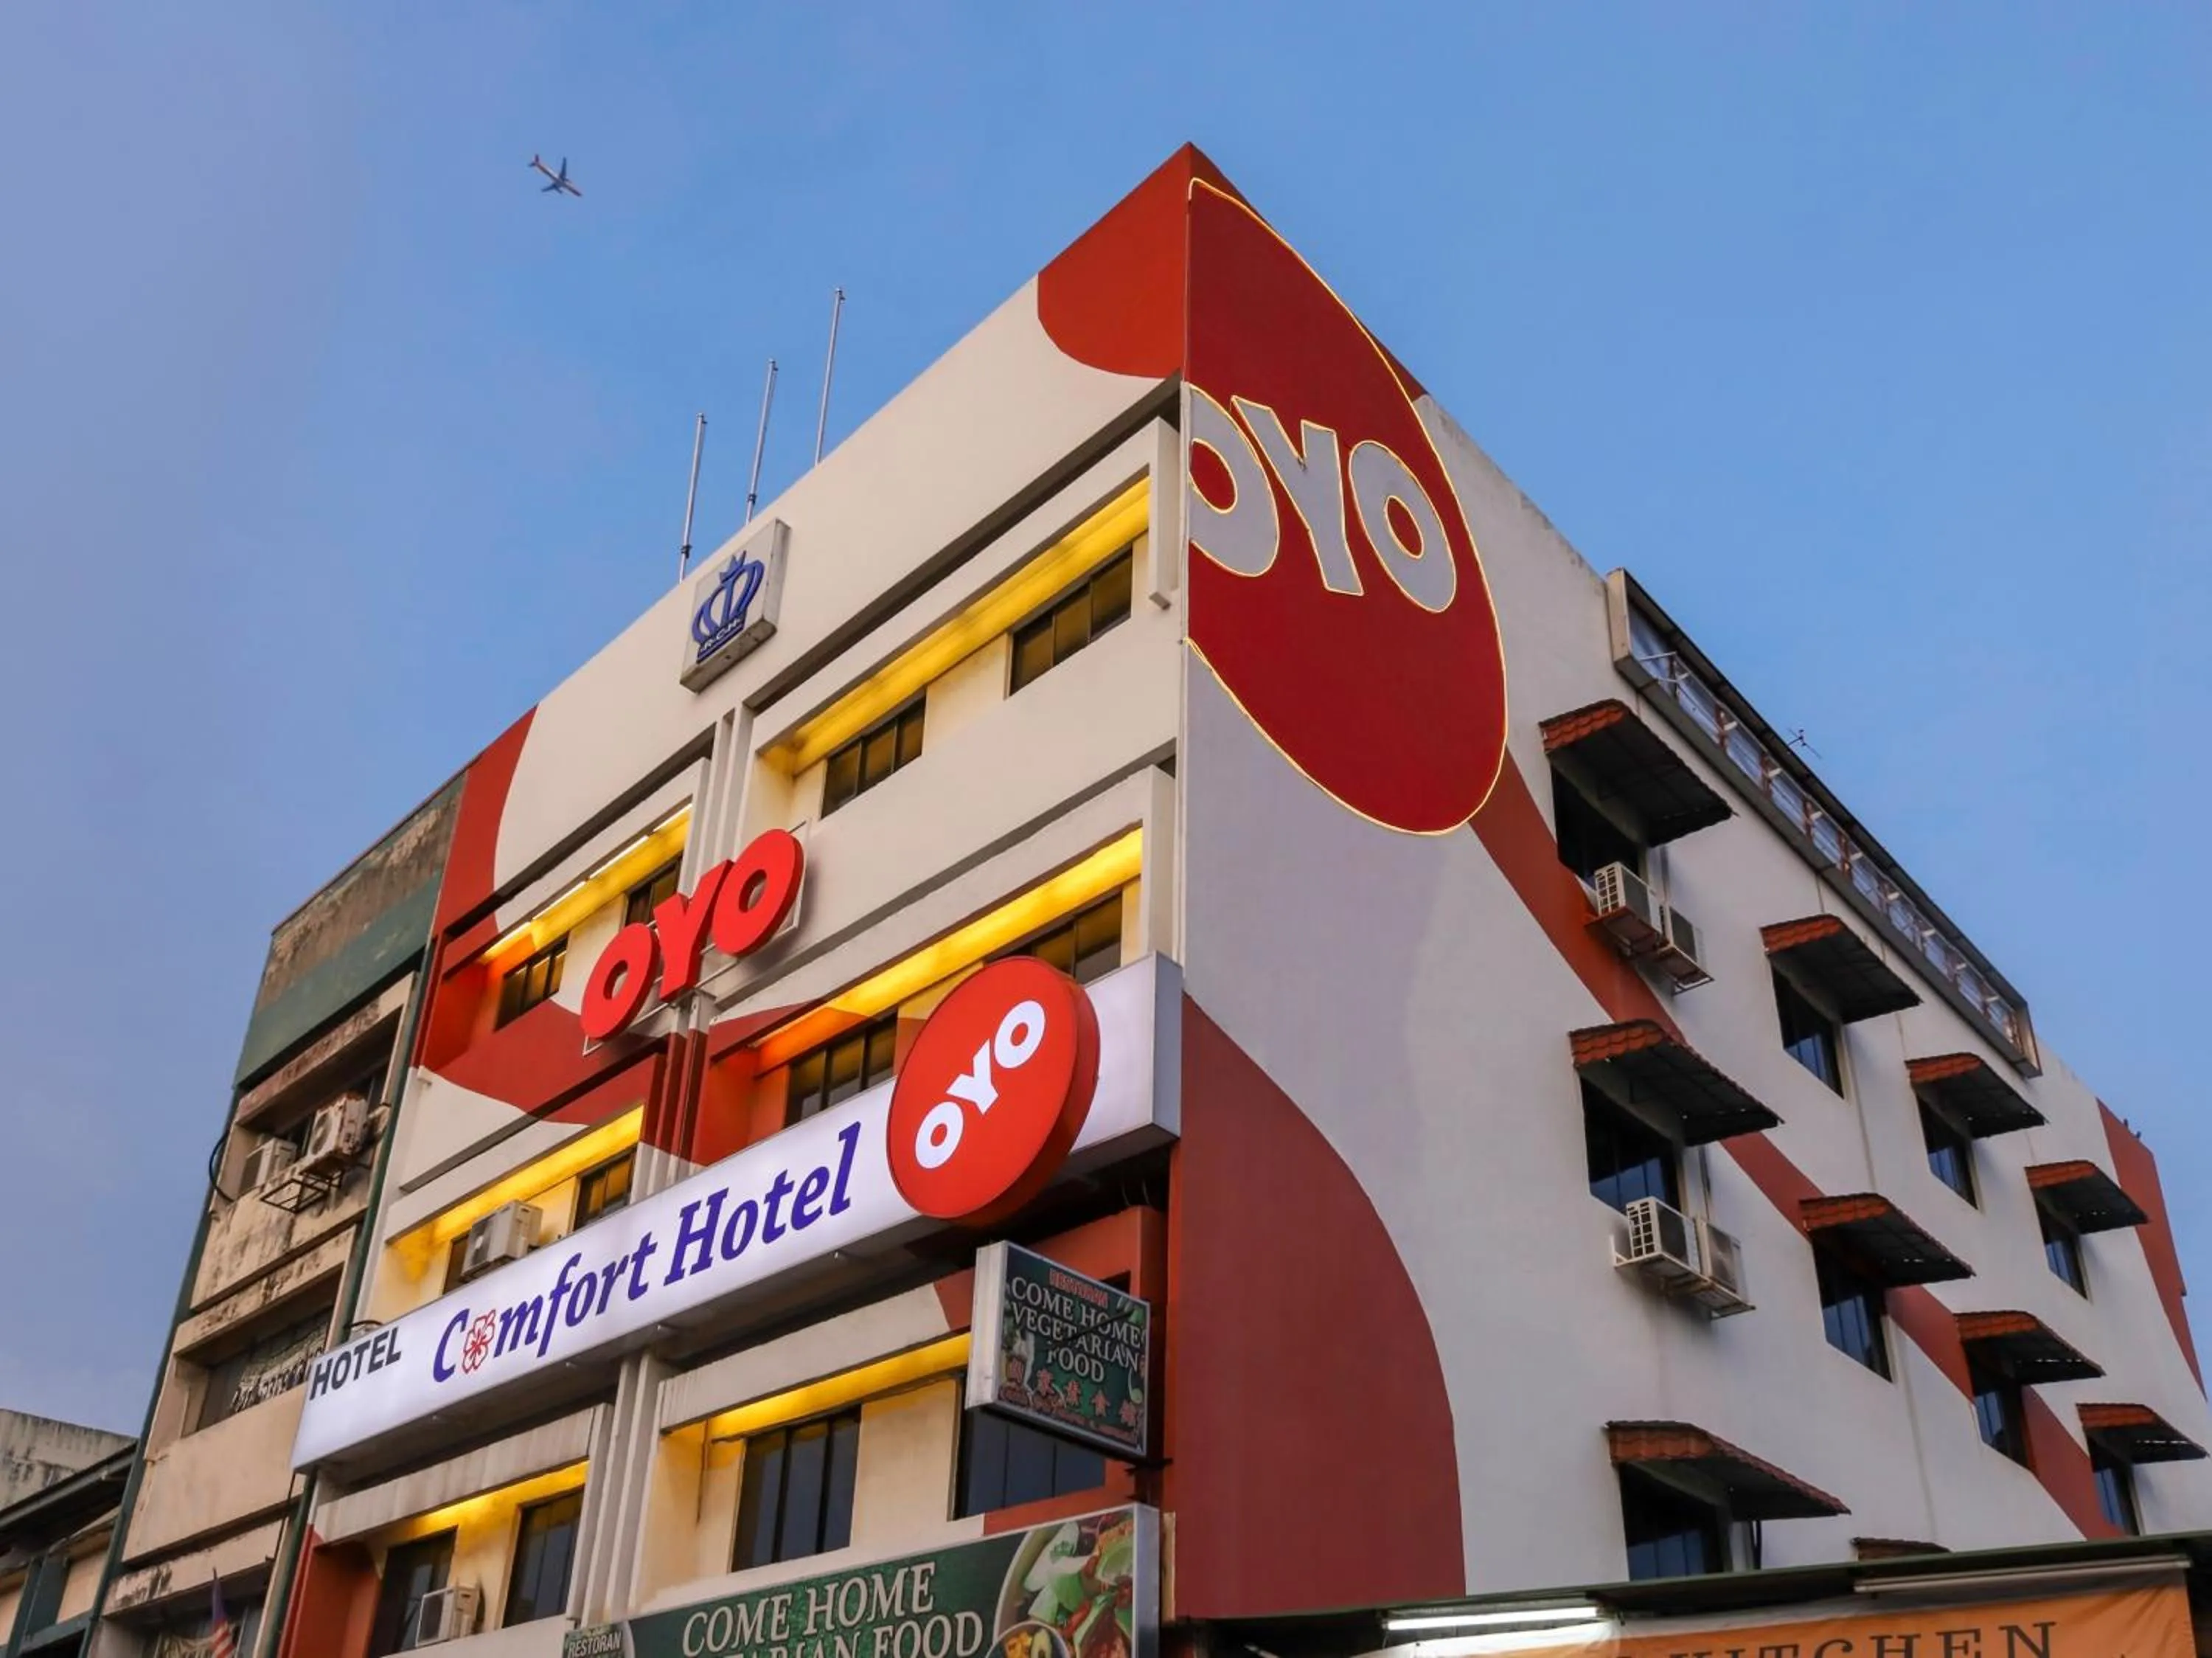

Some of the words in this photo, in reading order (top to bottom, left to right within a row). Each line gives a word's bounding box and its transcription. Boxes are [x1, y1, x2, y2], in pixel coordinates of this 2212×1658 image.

[1186, 381, 1457, 614] OYO
[580, 828, 804, 1041] OYO
[915, 1000, 1046, 1168] OYO
[310, 1327, 402, 1401] HOTEL
[664, 1121, 861, 1286] Hotel
[1012, 1277, 1074, 1320] COME
[1080, 1303, 1141, 1348] HOME
[1012, 1302, 1140, 1372] VEGETARIAN
[564, 1631, 622, 1658] RESTORAN
[683, 1593, 793, 1657] COME
[803, 1561, 936, 1636] HOME
[873, 1612, 984, 1658] FOOD
[1670, 1621, 2056, 1658] CHEN
